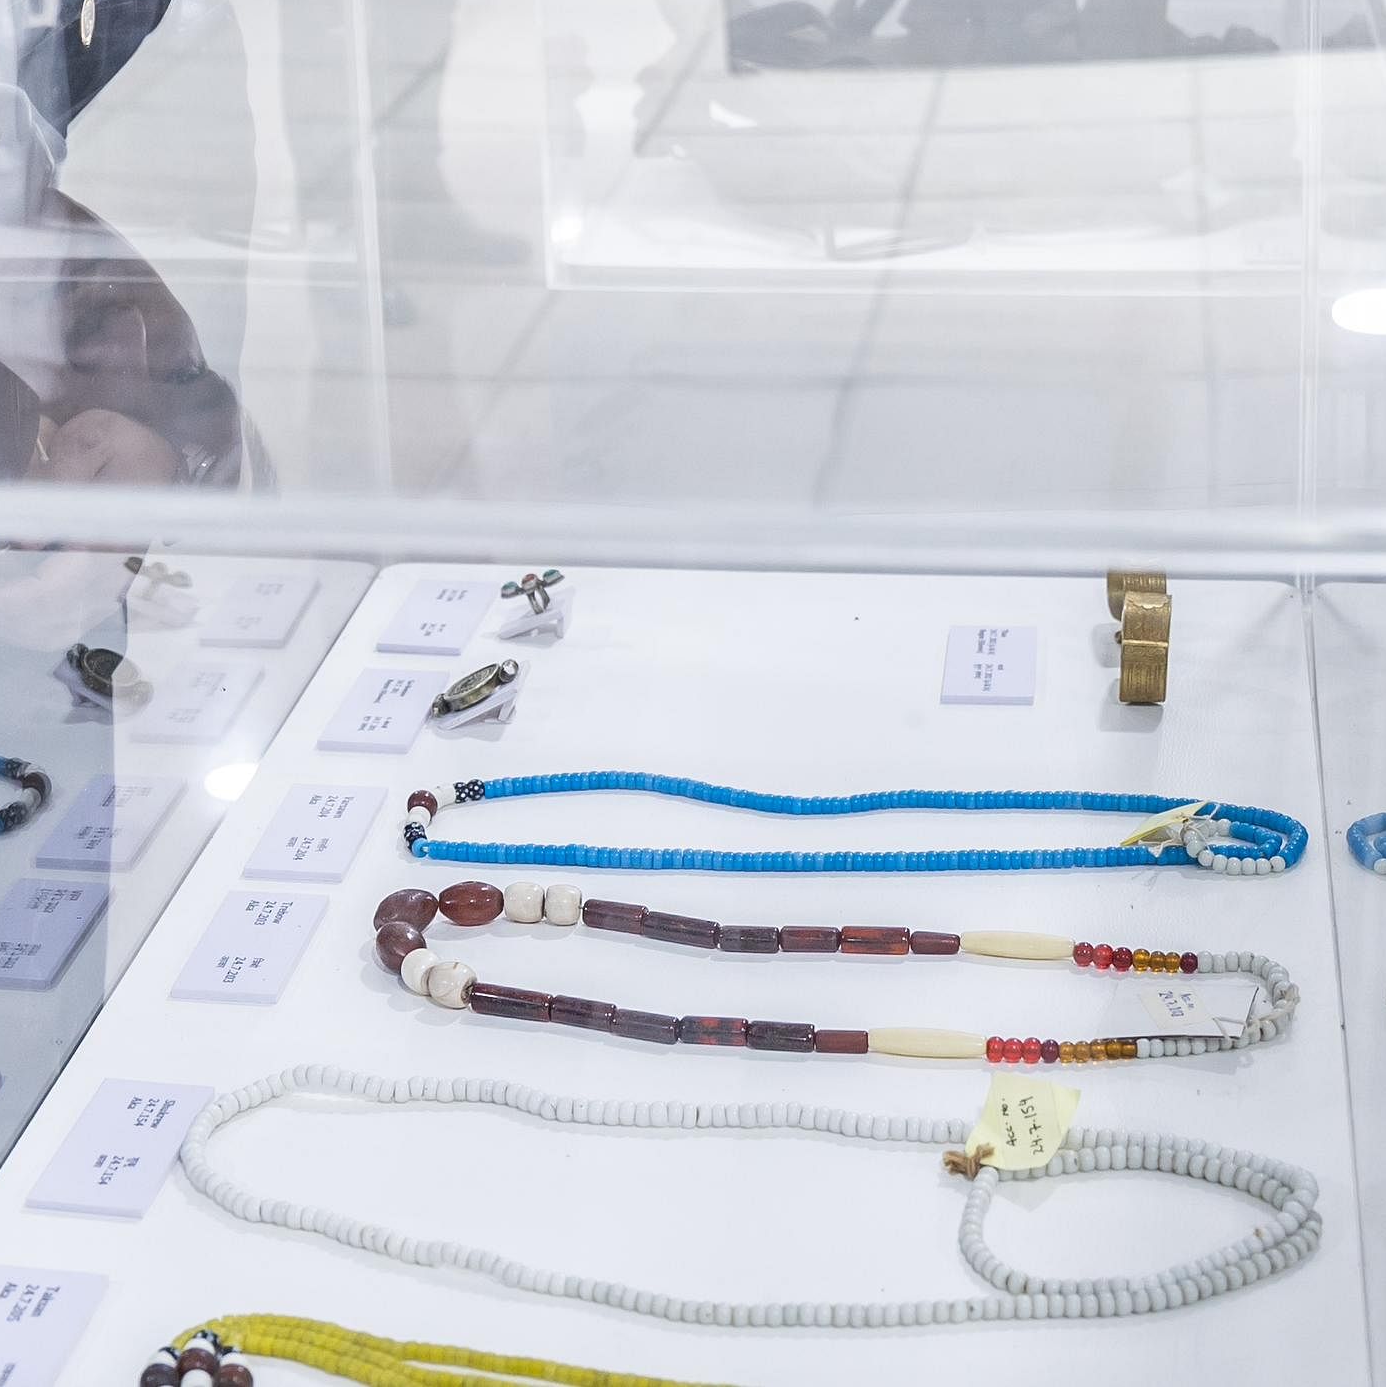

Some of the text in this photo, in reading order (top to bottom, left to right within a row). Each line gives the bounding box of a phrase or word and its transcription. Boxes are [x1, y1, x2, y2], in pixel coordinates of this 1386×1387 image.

[222, 956, 247, 983] 24.7.203
[126, 1096, 143, 1110] Aka
[133, 1097, 160, 1127] 24.7.154
[97, 1155, 124, 1186] 24.7.154
